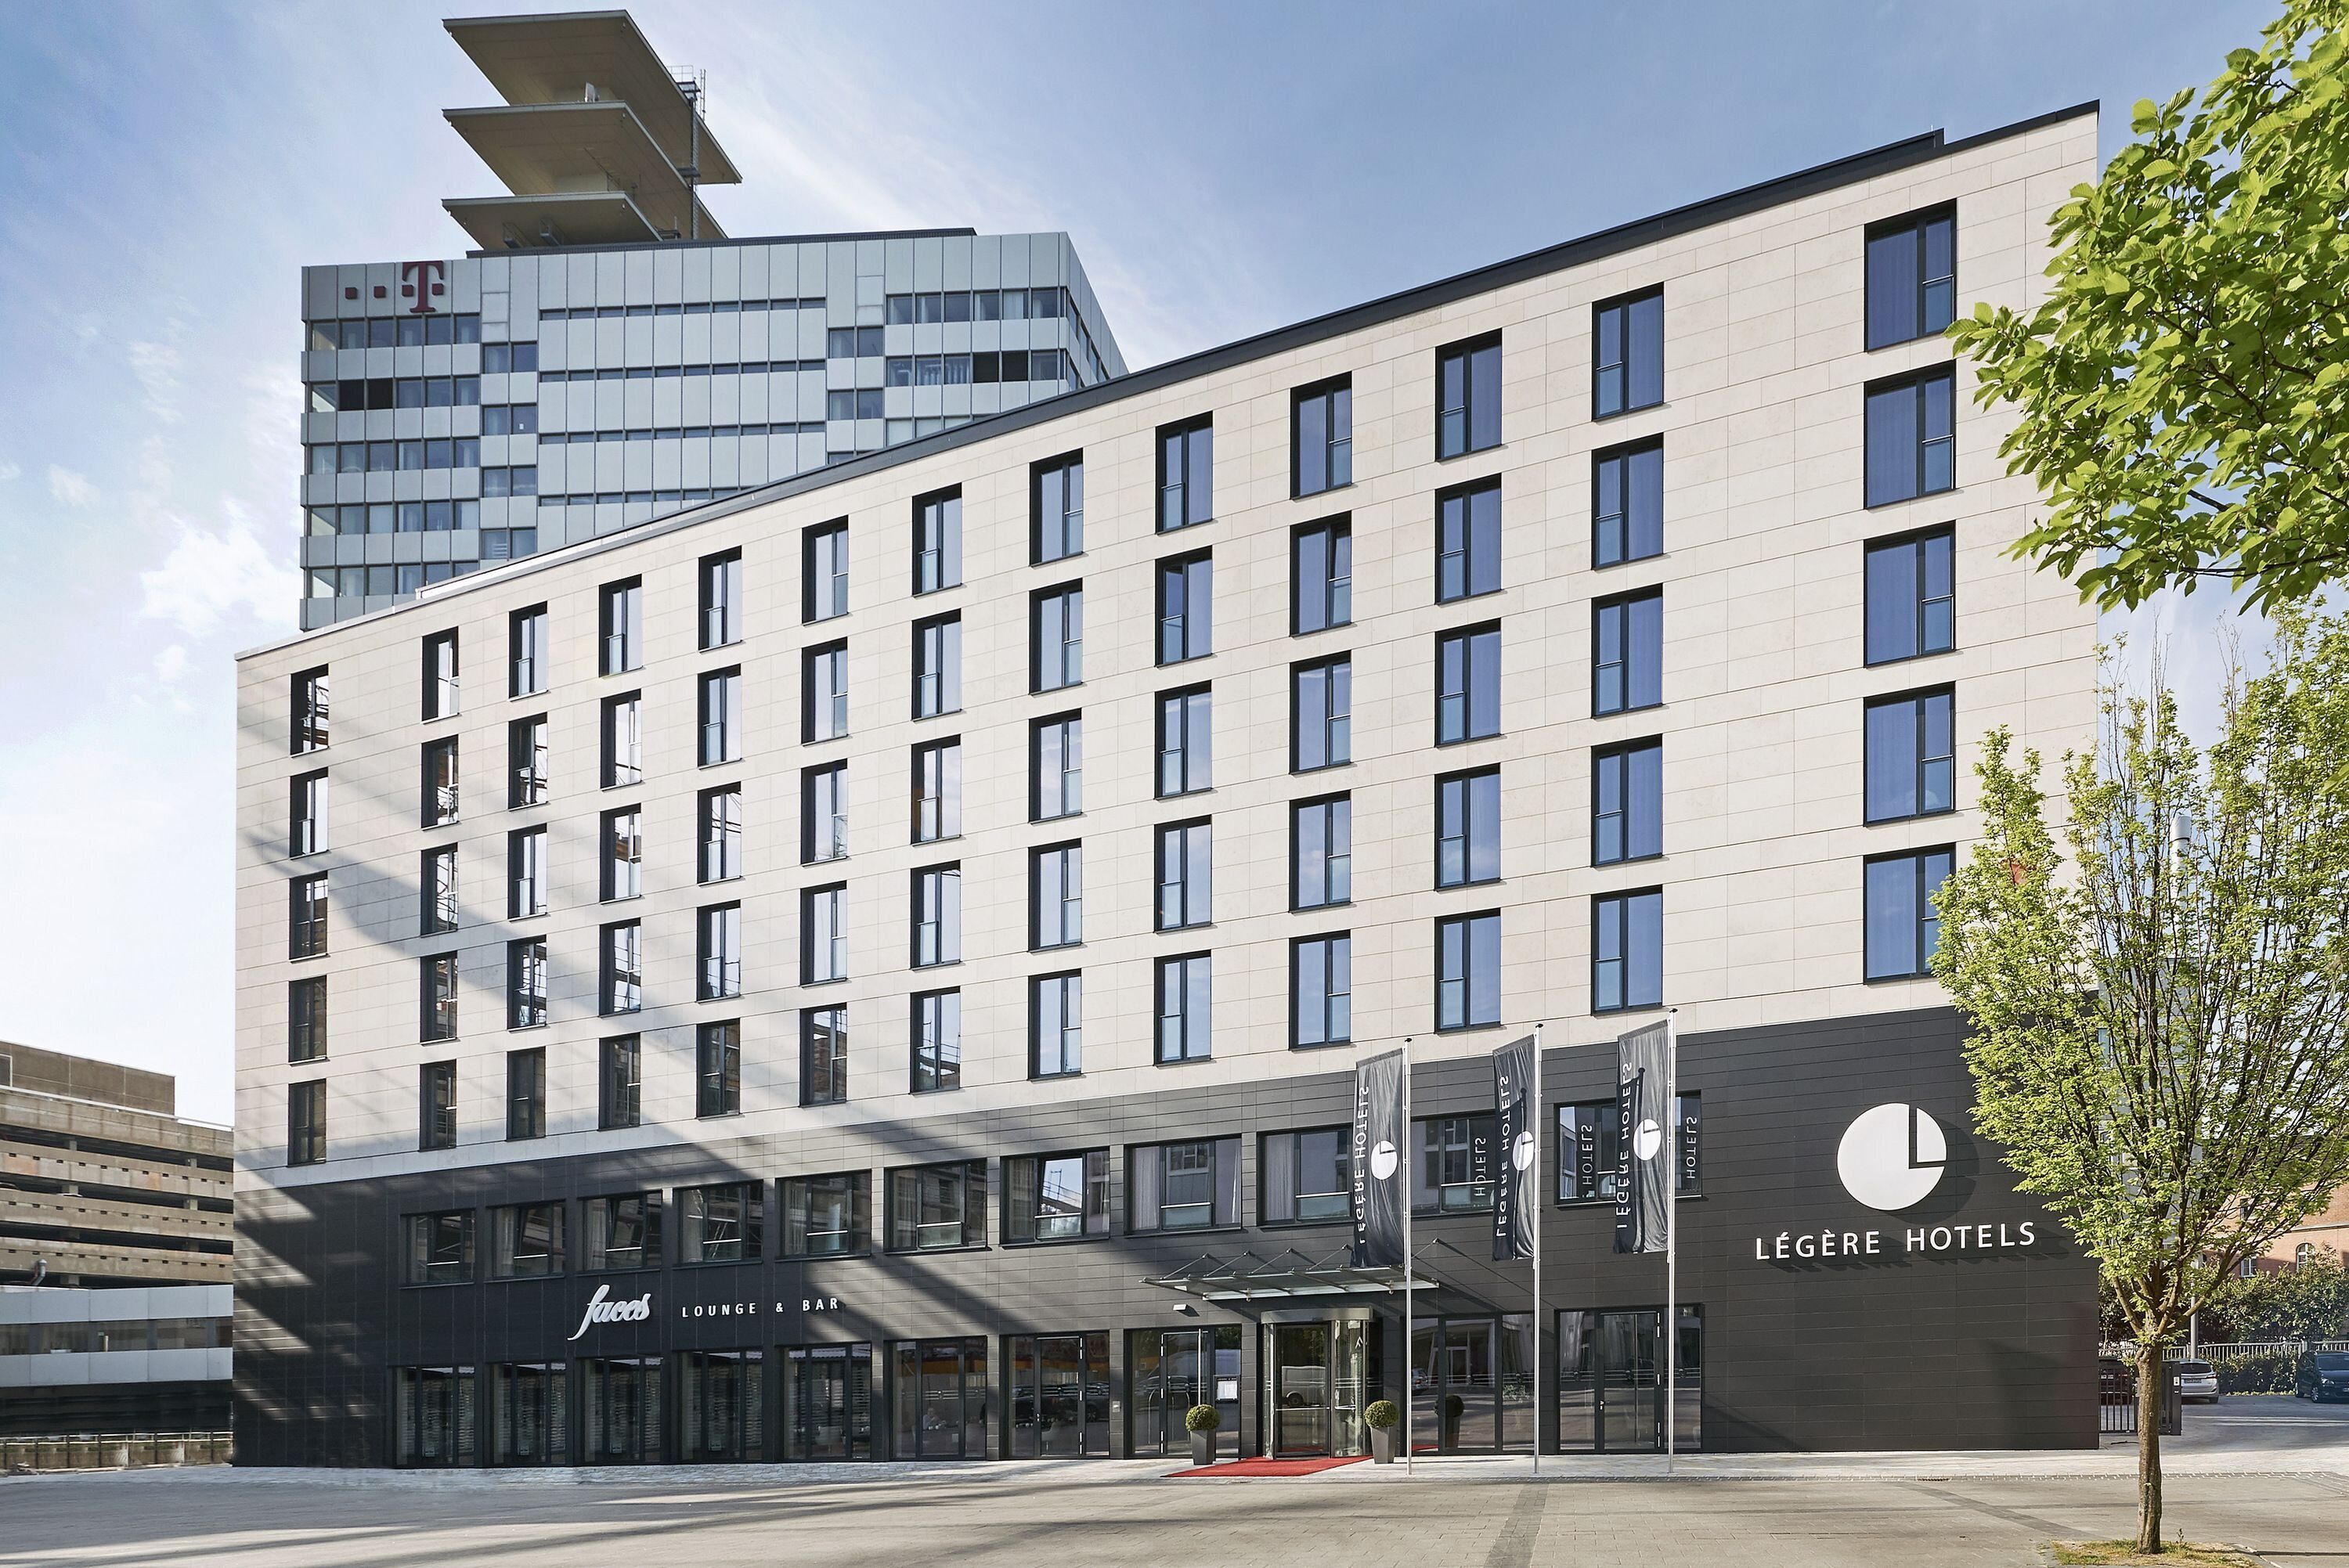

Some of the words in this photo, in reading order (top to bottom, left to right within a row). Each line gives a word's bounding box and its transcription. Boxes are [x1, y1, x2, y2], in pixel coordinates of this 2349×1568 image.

[402, 260, 444, 312] T
[1755, 1230, 1880, 1260] LÉGÈRE
[1907, 1221, 2036, 1252] HOTELS
[567, 1284, 651, 1341] faces
[682, 1302, 756, 1317] LOUNGE
[775, 1302, 784, 1313] &
[802, 1297, 839, 1312] BAR
